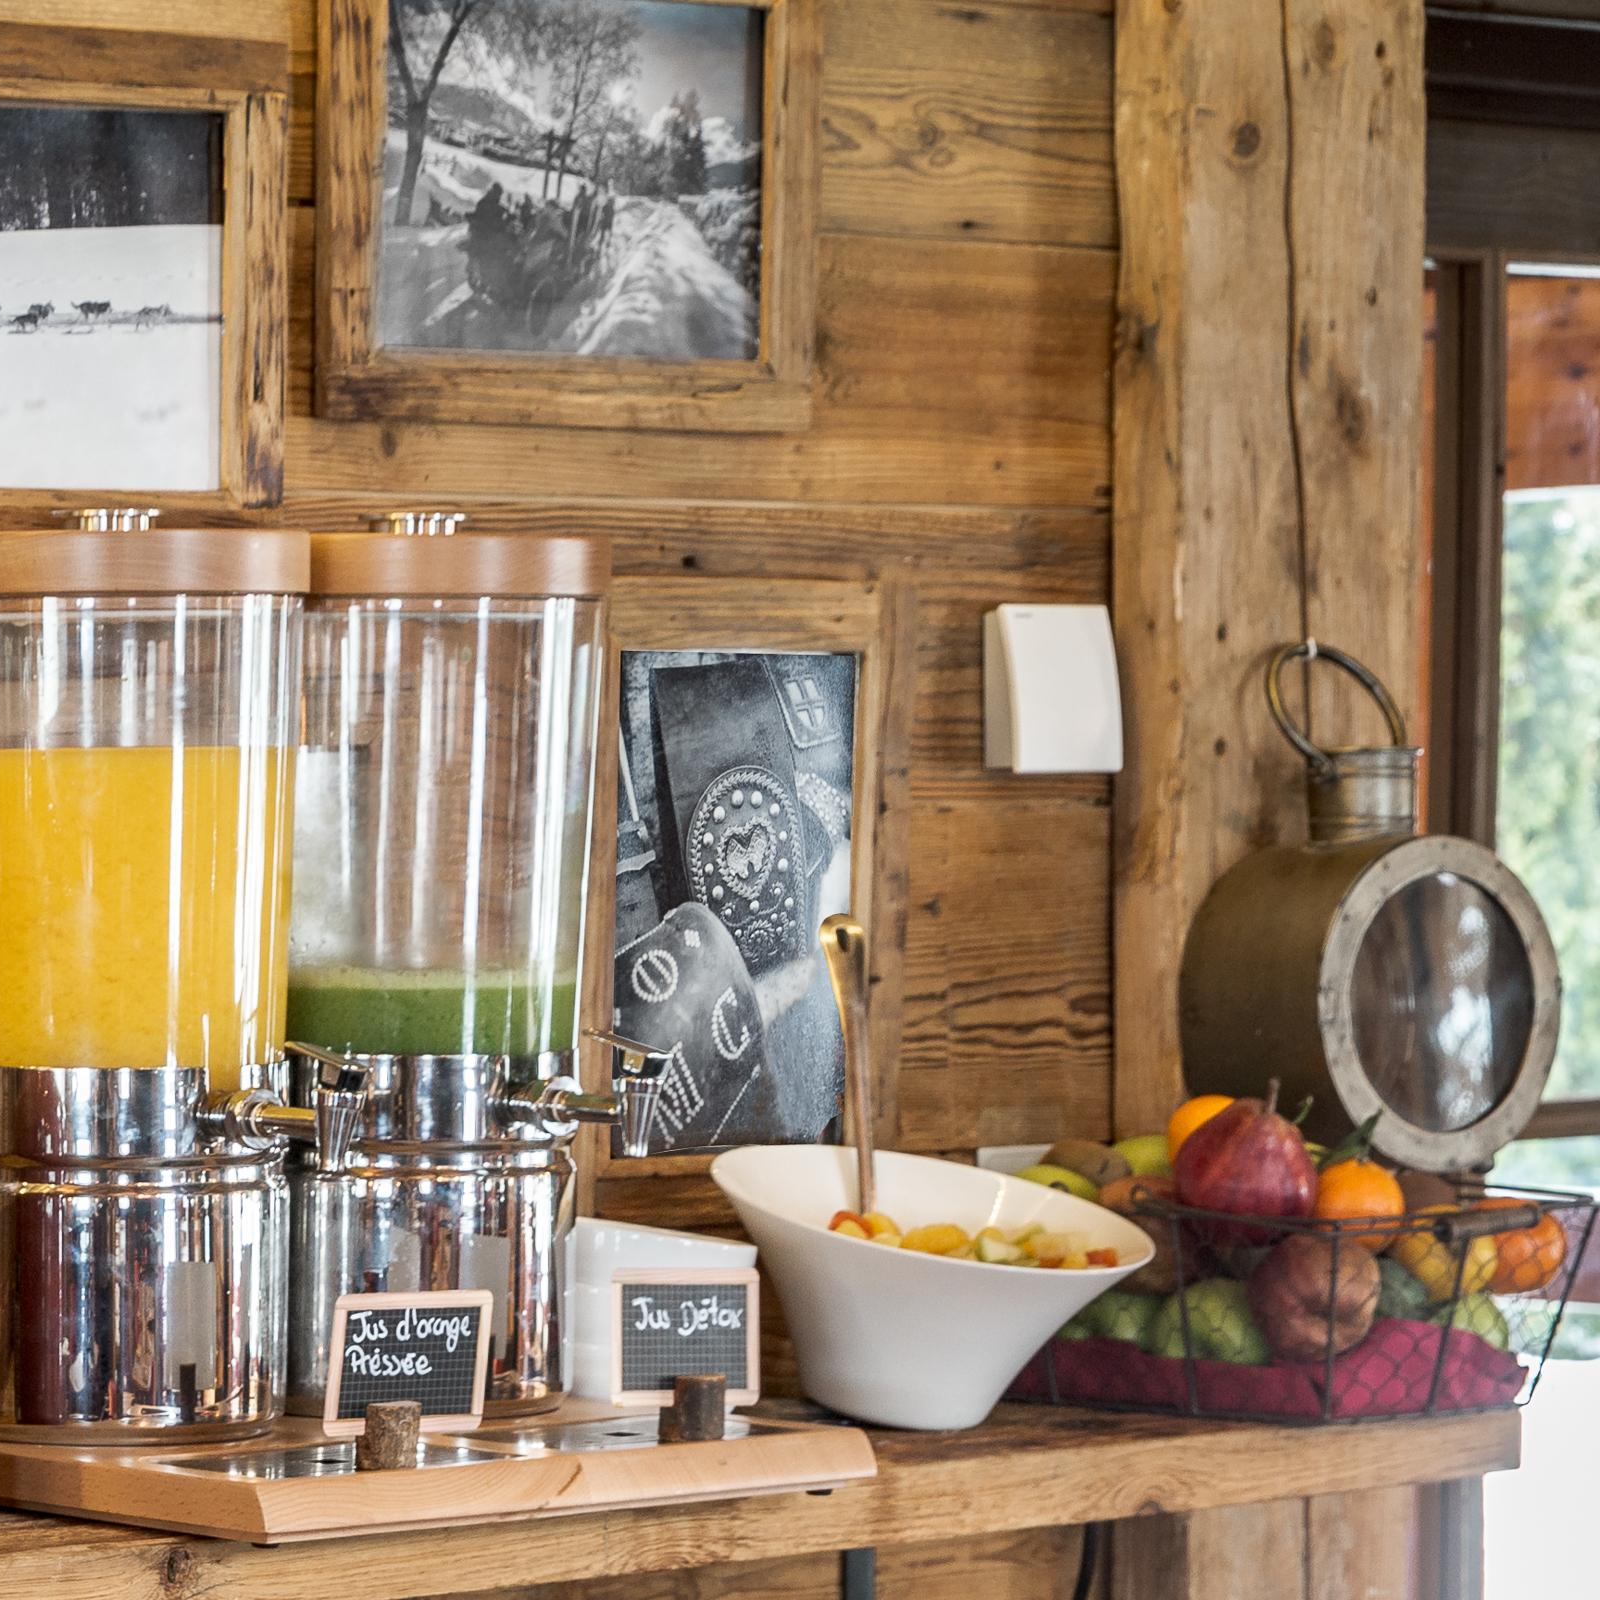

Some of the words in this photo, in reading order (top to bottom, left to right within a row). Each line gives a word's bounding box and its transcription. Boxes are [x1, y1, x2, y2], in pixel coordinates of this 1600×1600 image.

[350, 1310, 388, 1343] Jus
[396, 1308, 471, 1352] d'orange
[631, 1296, 671, 1331] Jus
